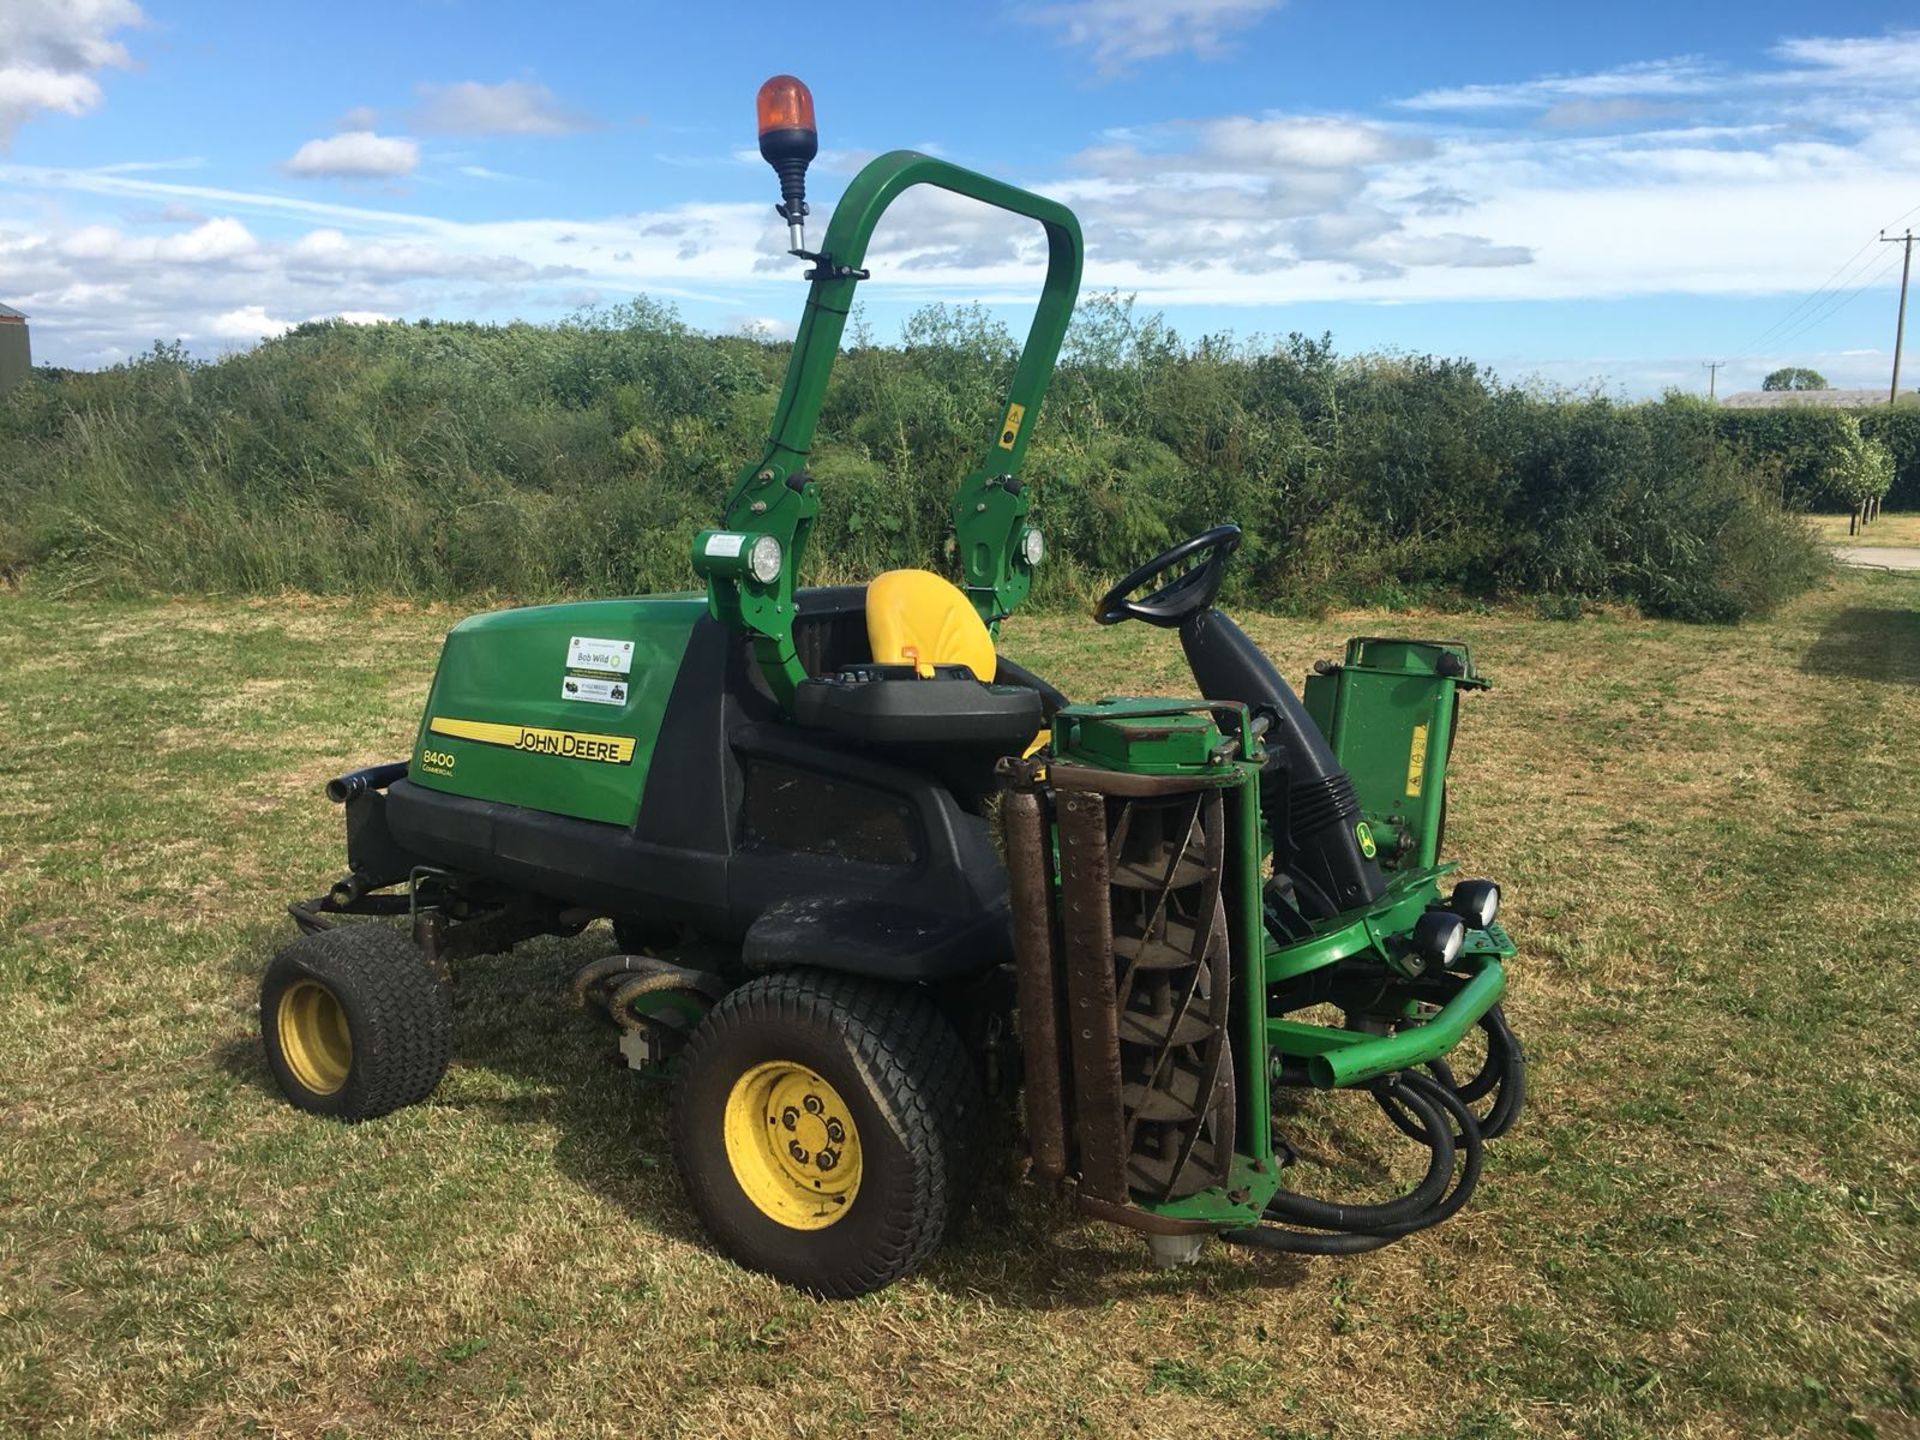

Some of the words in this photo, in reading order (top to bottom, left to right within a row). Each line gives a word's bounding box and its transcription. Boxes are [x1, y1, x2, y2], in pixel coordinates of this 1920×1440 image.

[578, 652, 592, 662] Bob
[593, 653, 610, 664] Wild
[515, 729, 559, 754] JOHN
[562, 735, 620, 760] DEERE
[424, 750, 455, 767] 8400
